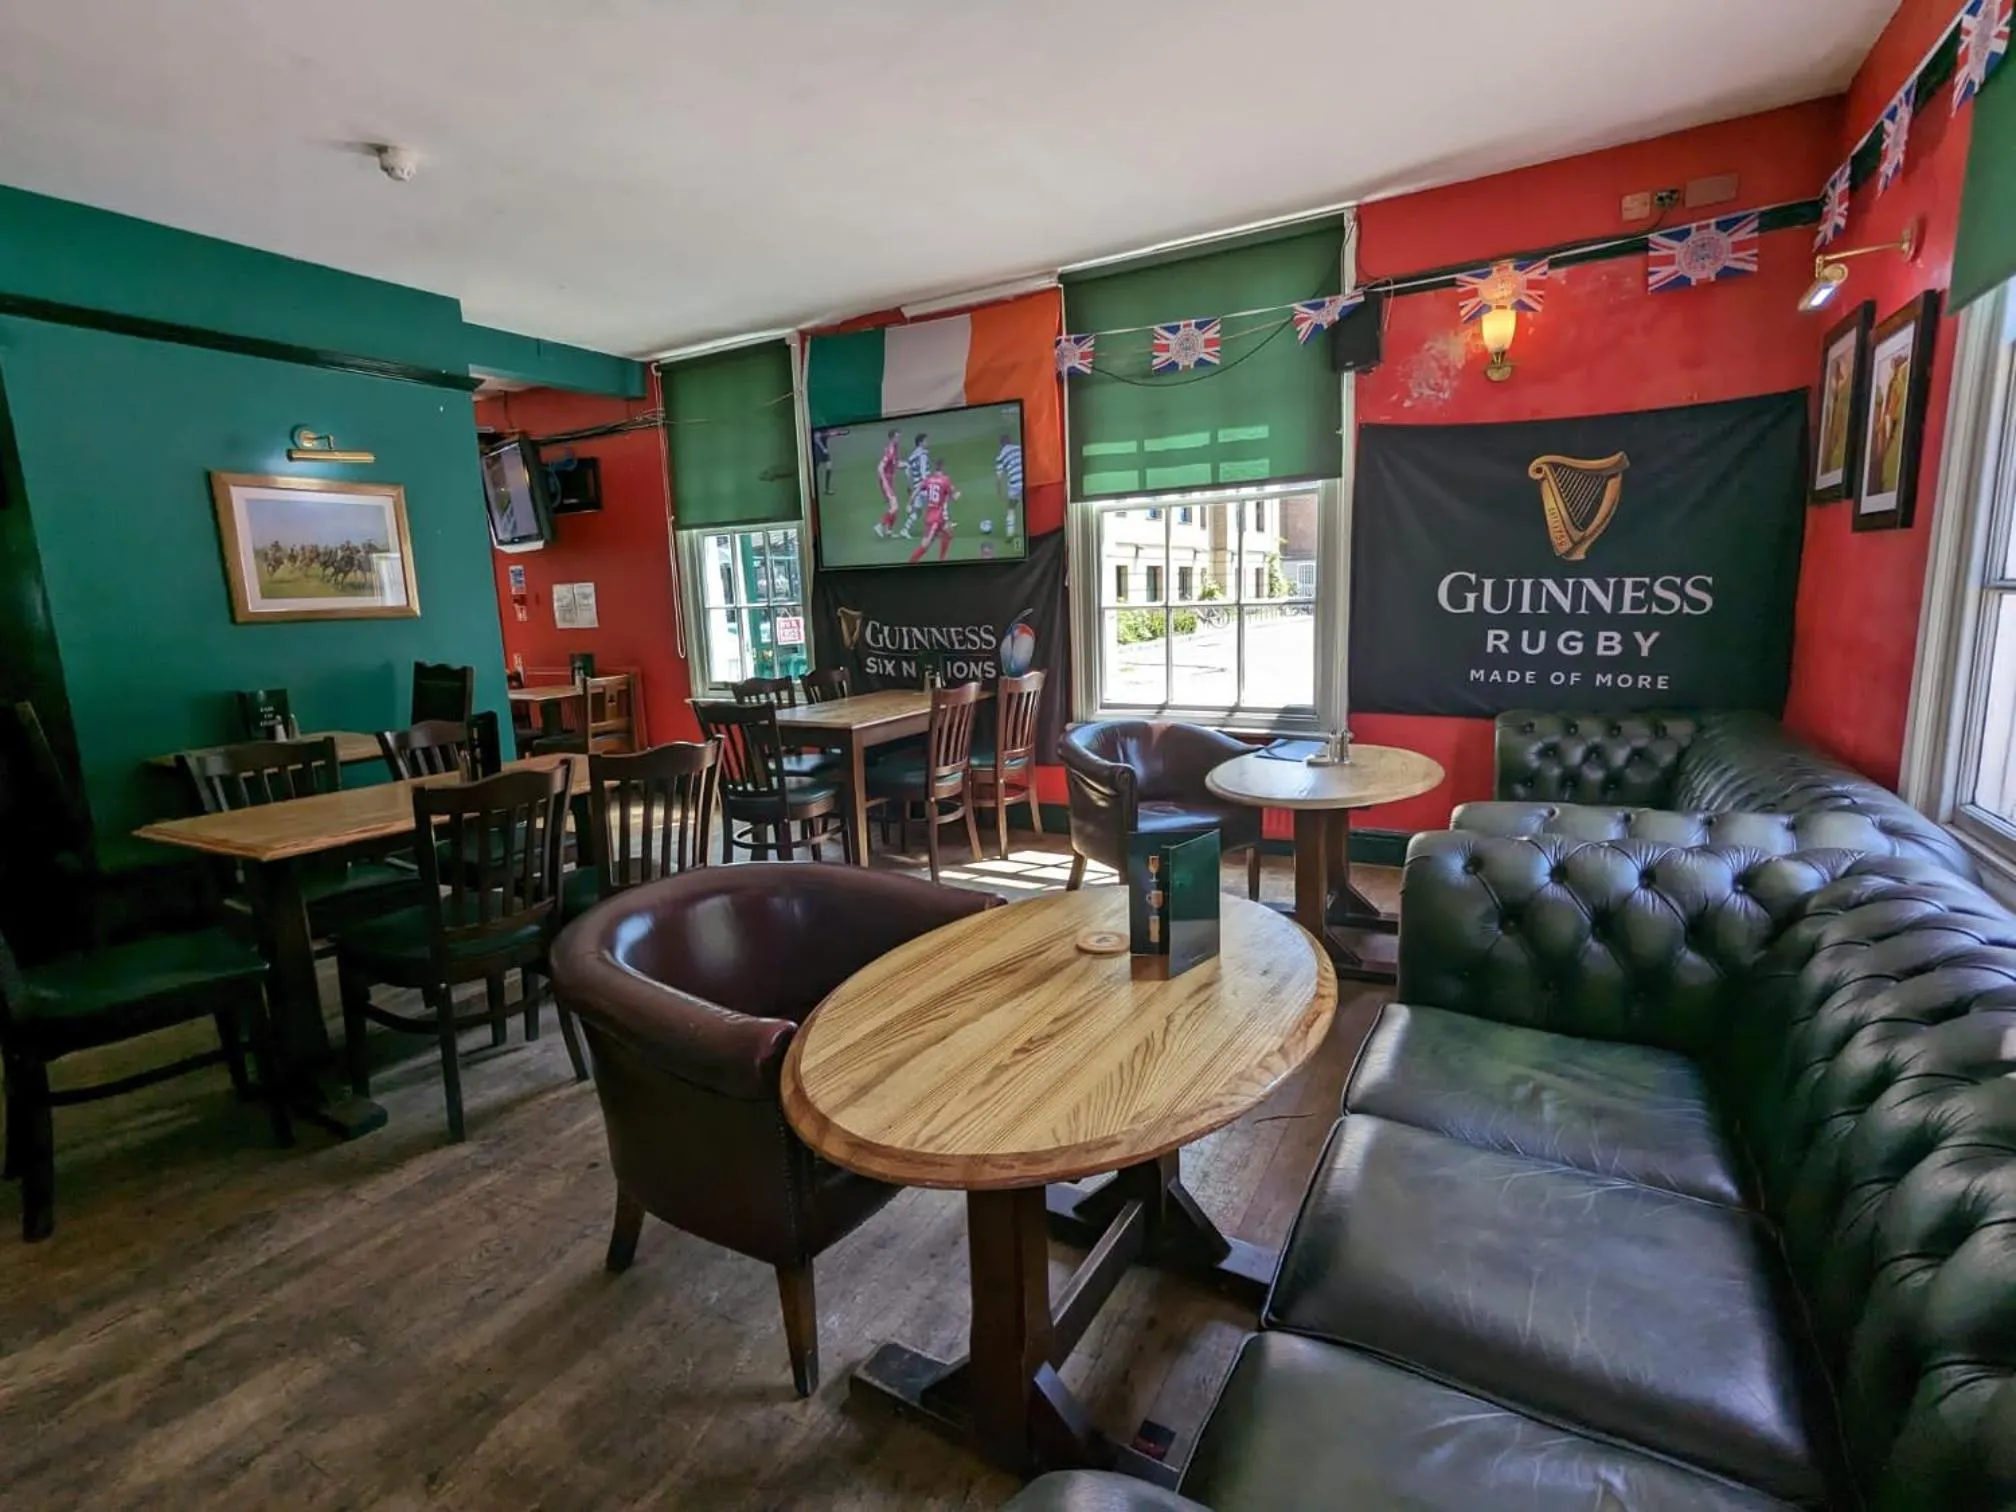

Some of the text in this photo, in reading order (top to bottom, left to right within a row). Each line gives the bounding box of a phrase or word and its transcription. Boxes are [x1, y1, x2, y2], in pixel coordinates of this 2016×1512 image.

[1437, 571, 1714, 615] GUINNESS
[865, 620, 997, 650] GUINNESS
[1486, 629, 1661, 657] RUGBY
[865, 657, 997, 679] SIX NIONS
[1469, 668, 1670, 690] MADE OF MORE
